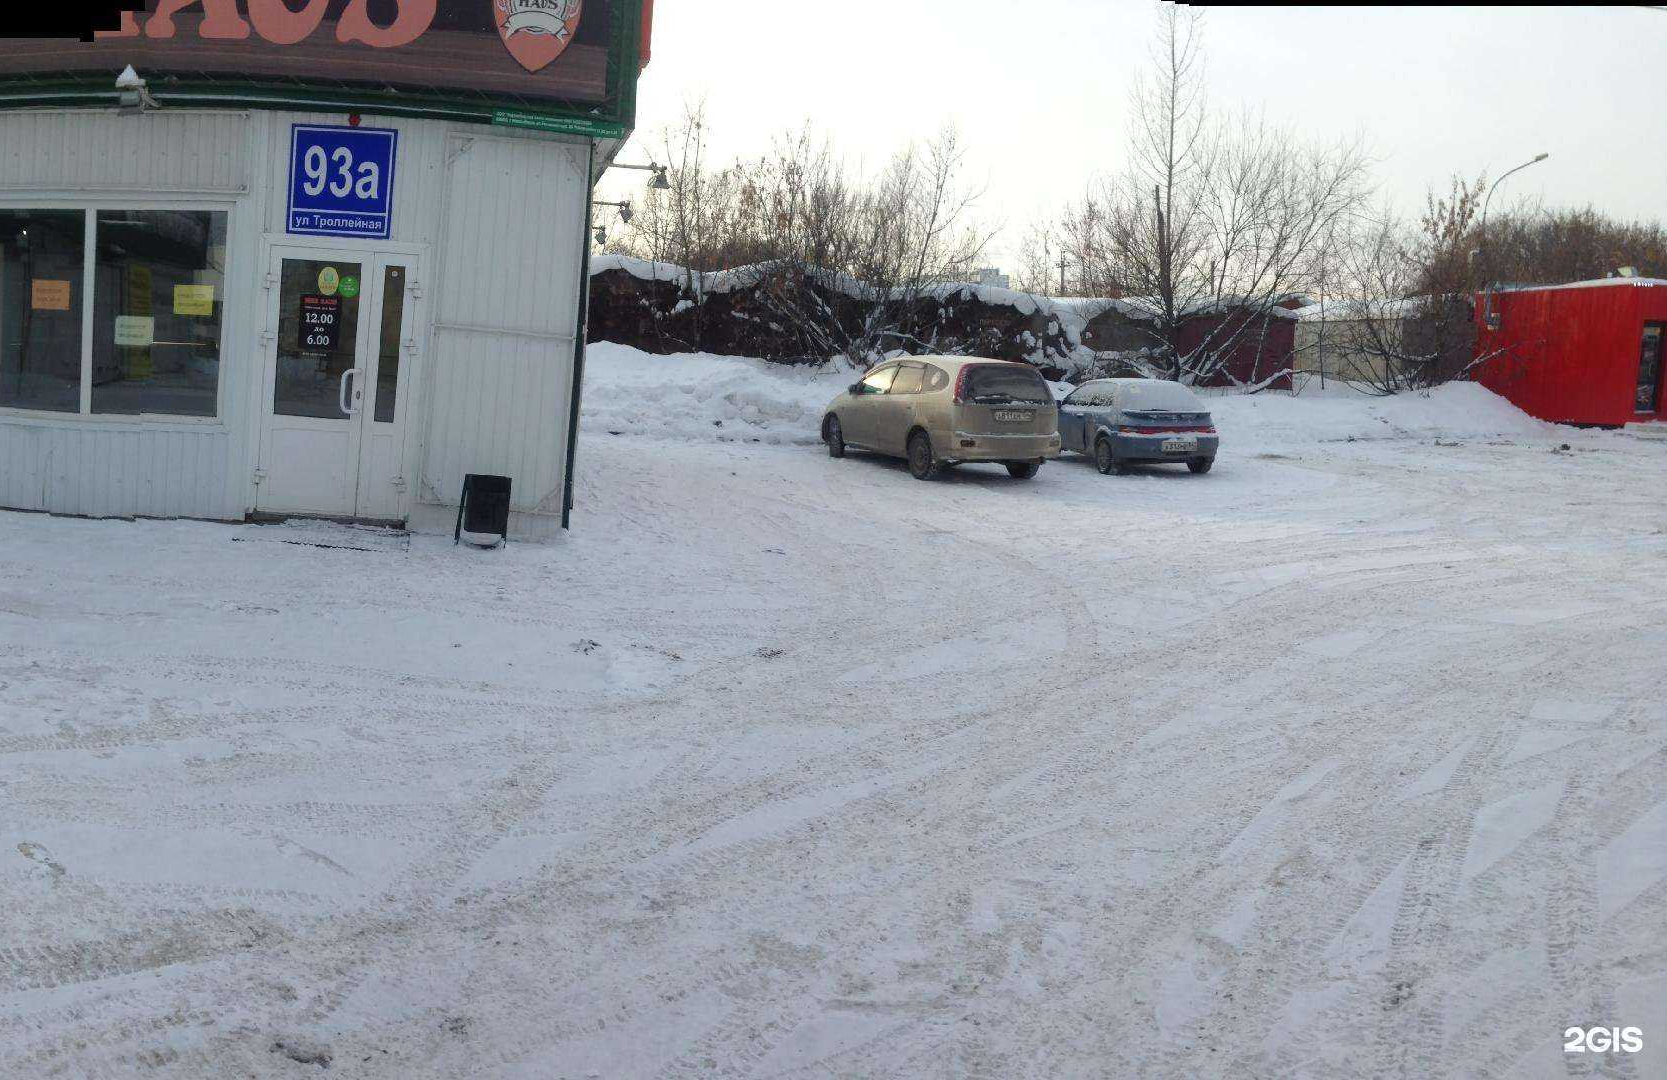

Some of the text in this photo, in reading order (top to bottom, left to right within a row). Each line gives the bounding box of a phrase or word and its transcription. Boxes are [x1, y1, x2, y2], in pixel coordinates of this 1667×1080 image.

[303, 145, 379, 199] 93а
[295, 215, 382, 229] ул Троллейная
[305, 313, 334, 324] 12.00
[307, 335, 329, 345] 6.00
